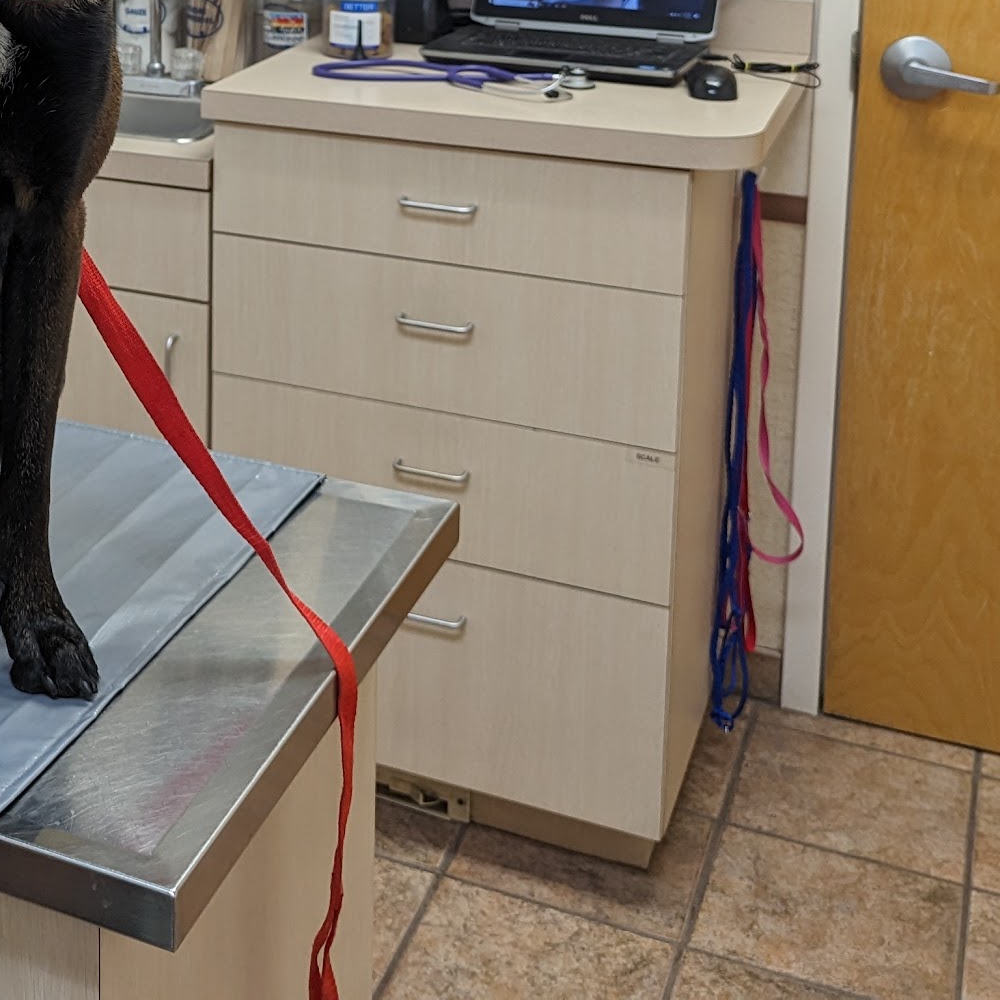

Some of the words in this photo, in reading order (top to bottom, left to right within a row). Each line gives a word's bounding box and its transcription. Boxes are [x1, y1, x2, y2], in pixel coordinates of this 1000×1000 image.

[125, 7, 147, 16] GAUZE
[343, 3, 375, 11] BETTER
[635, 452, 660, 463] SCALE
